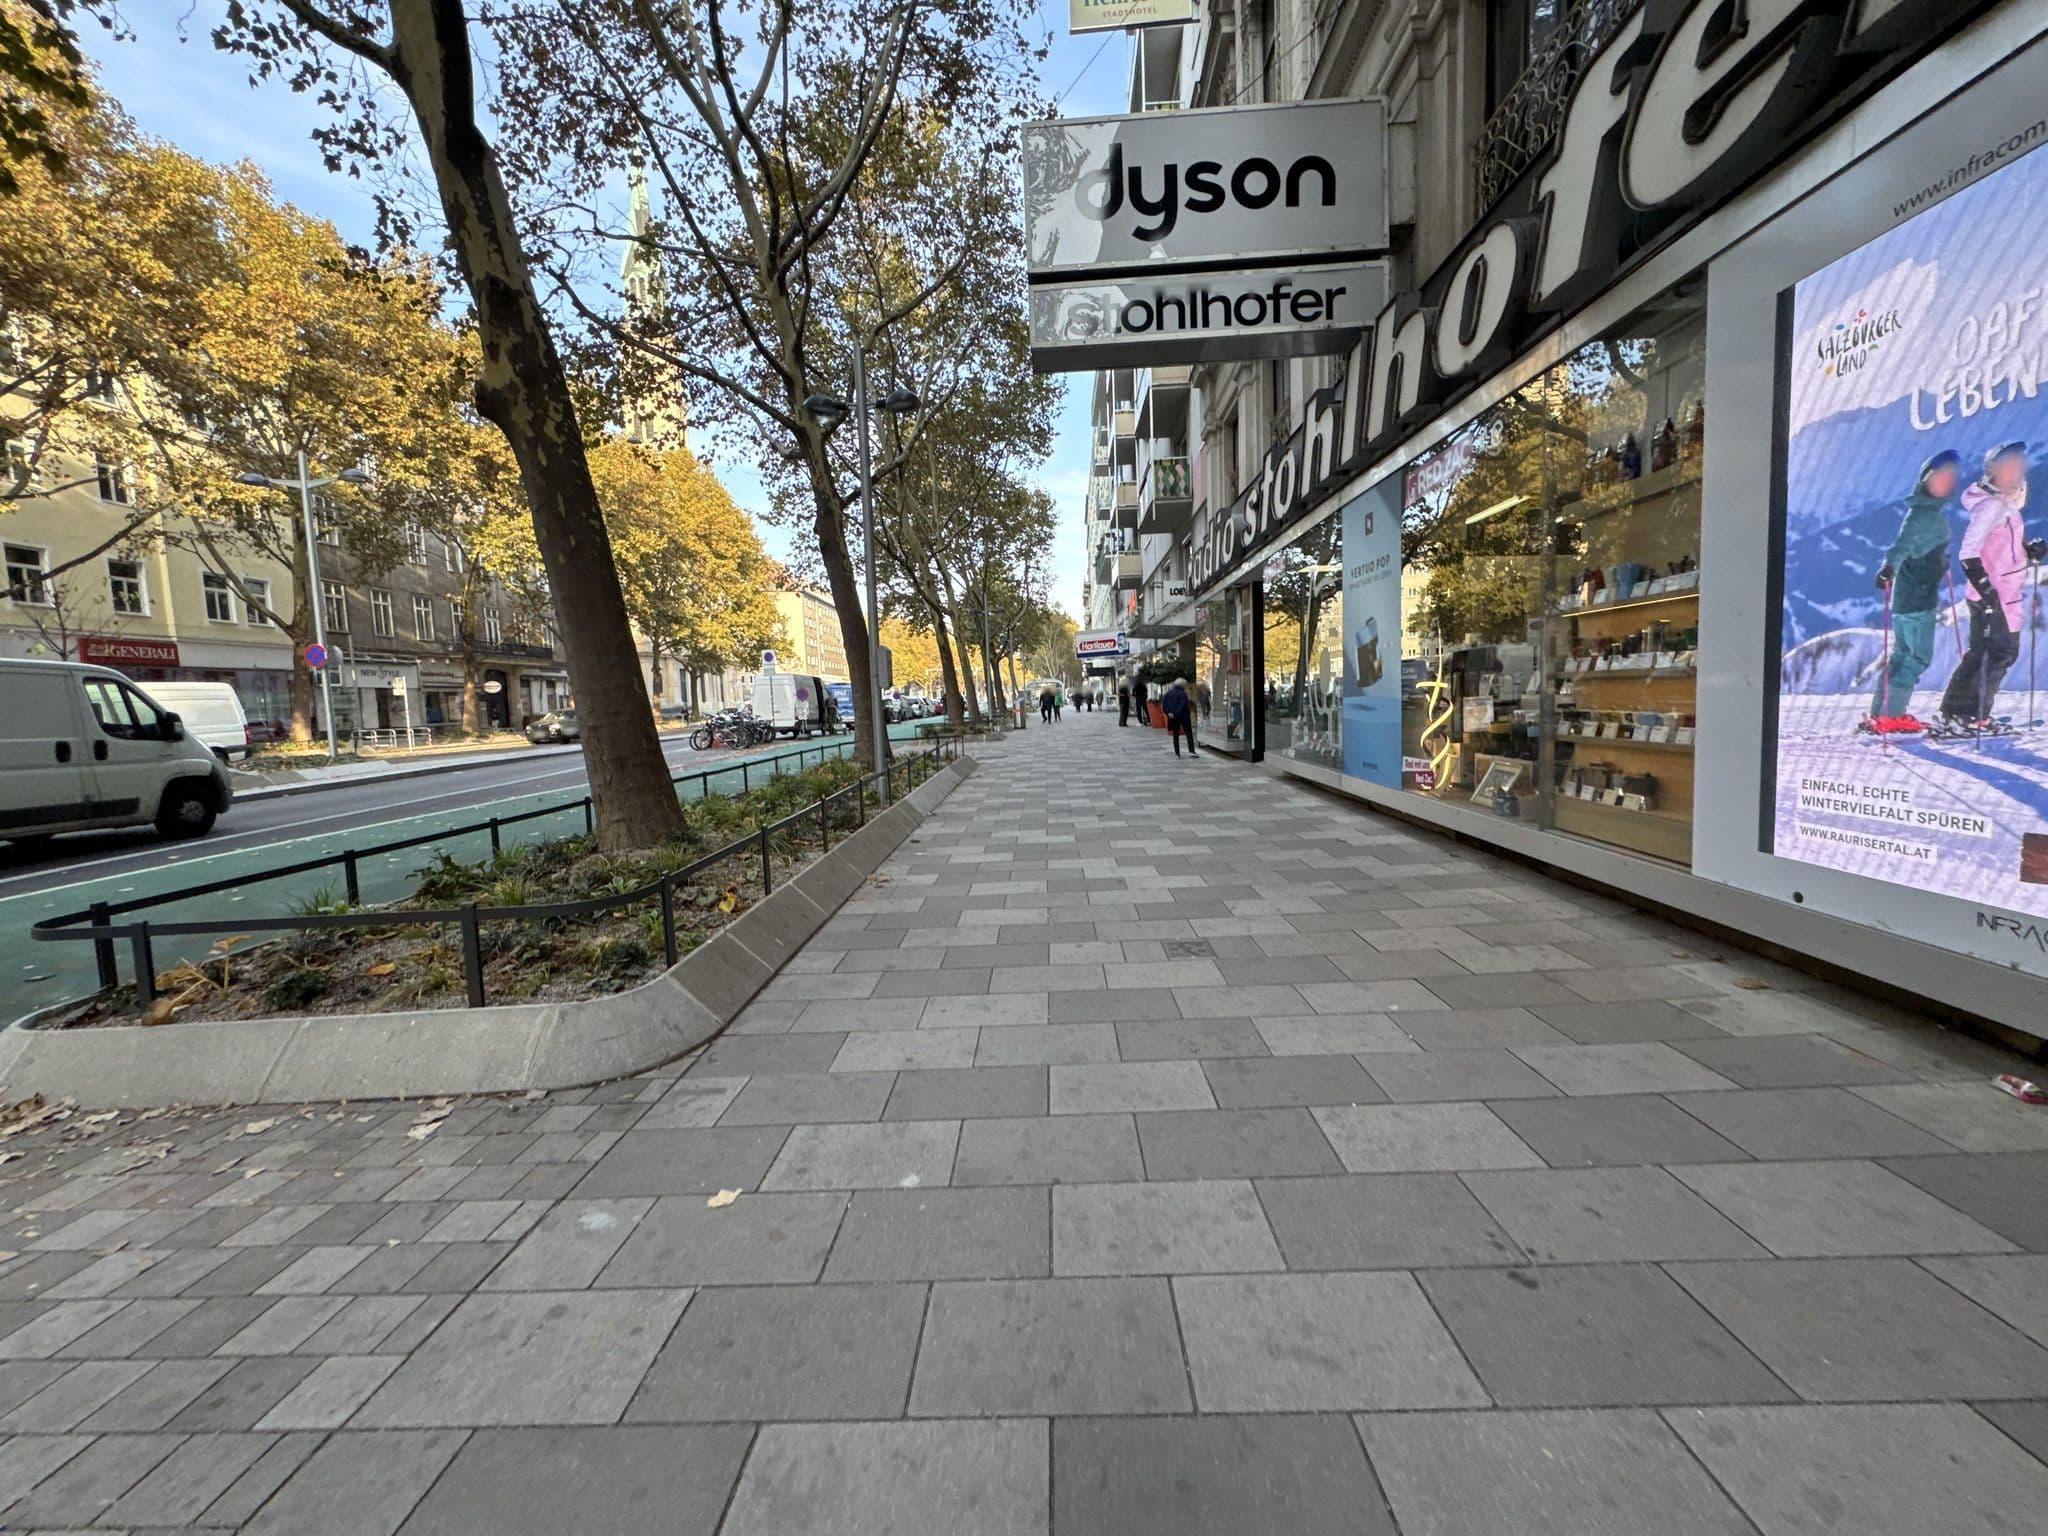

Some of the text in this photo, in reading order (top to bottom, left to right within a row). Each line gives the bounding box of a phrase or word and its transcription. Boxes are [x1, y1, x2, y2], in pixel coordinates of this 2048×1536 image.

[1103, 7, 1157, 18] STADTHOTEL
[1074, 143, 1336, 242] dyson
[1065, 281, 1346, 337] stohlhofer
[1187, 0, 1904, 589] radio stohlhofe
[1818, 310, 1902, 368] SALZBURGER
[1836, 349, 1867, 377] LAND
[1910, 343, 2040, 430] LEBEN
[1417, 439, 1471, 494] RED ZAC
[1351, 554, 1391, 579] VERTUO POP
[1169, 588, 1186, 596] LOE
[111, 645, 176, 660] GENERALI
[361, 669, 377, 677] NEW
[1802, 779, 1910, 803] EINFACH. ECHTE
[1801, 794, 1985, 833] WINTERVIELFALT SPÜREN
[1800, 825, 1931, 859] WWW.RAURISERTAL.AT
